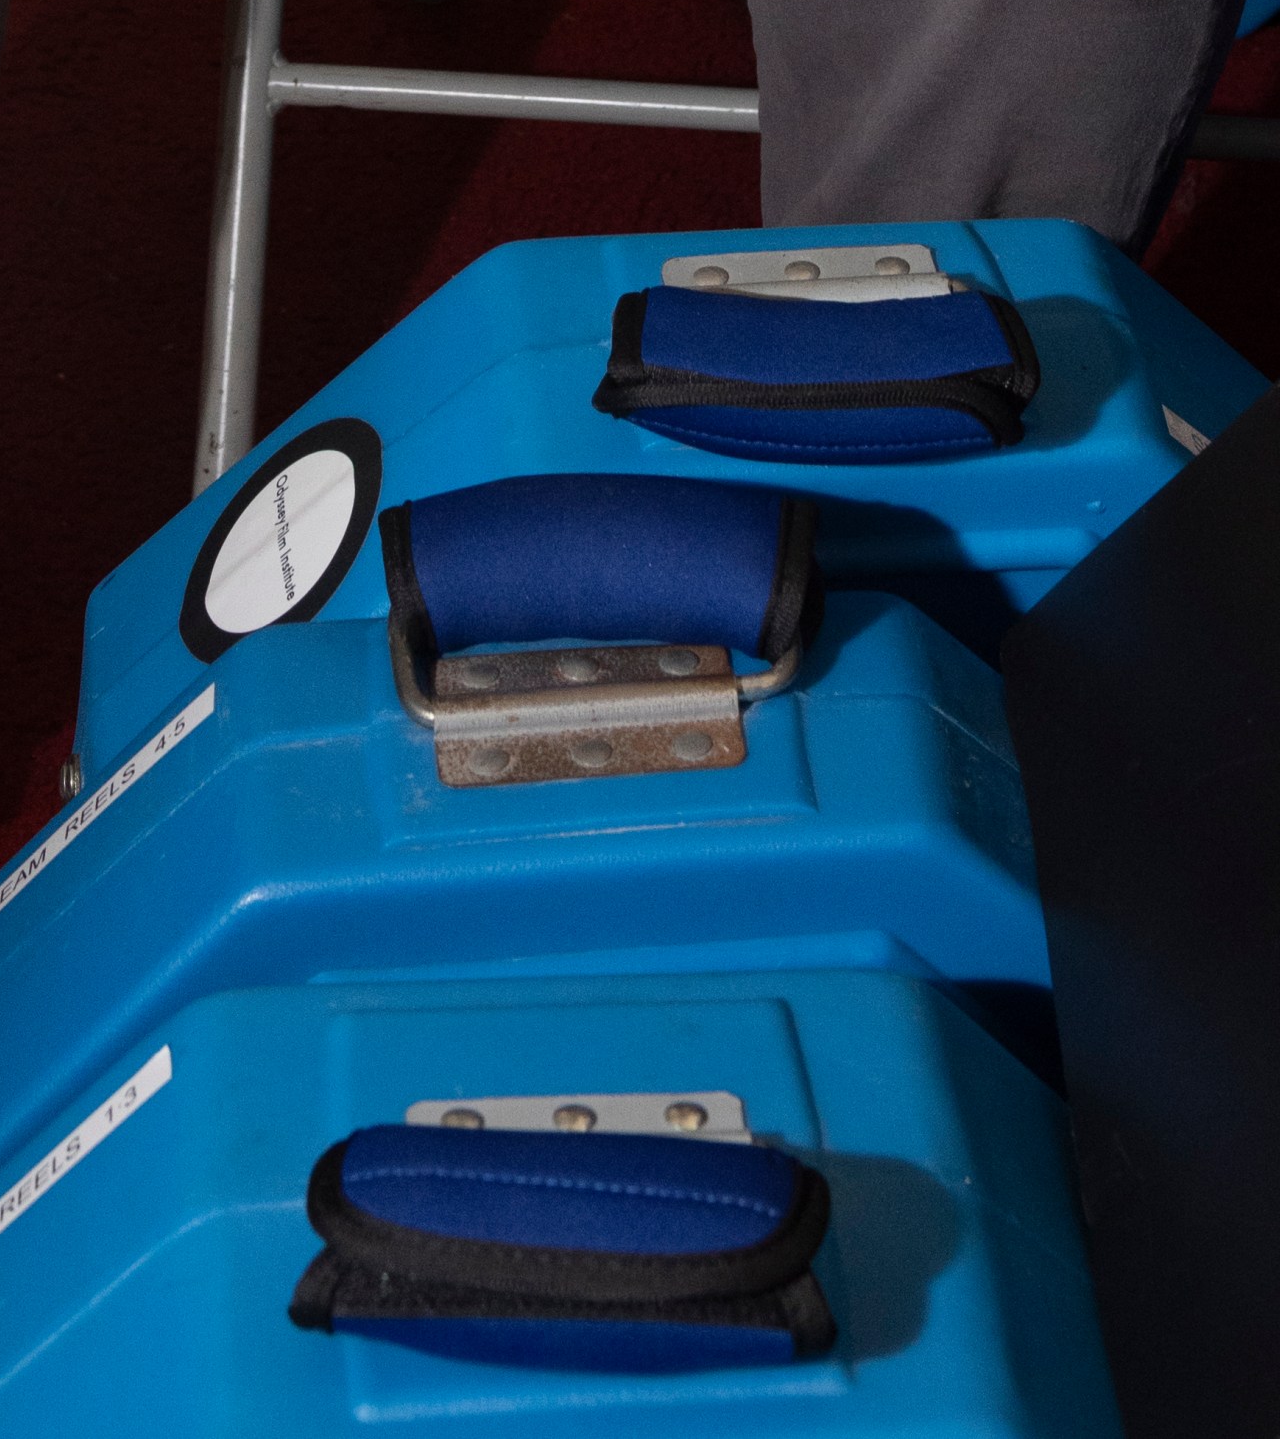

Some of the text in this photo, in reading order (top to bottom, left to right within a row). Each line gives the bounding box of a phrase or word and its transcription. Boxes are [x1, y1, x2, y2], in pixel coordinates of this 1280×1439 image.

[274, 474, 295, 601] Odyssey Film Institute
[65, 763, 137, 840] REELS
